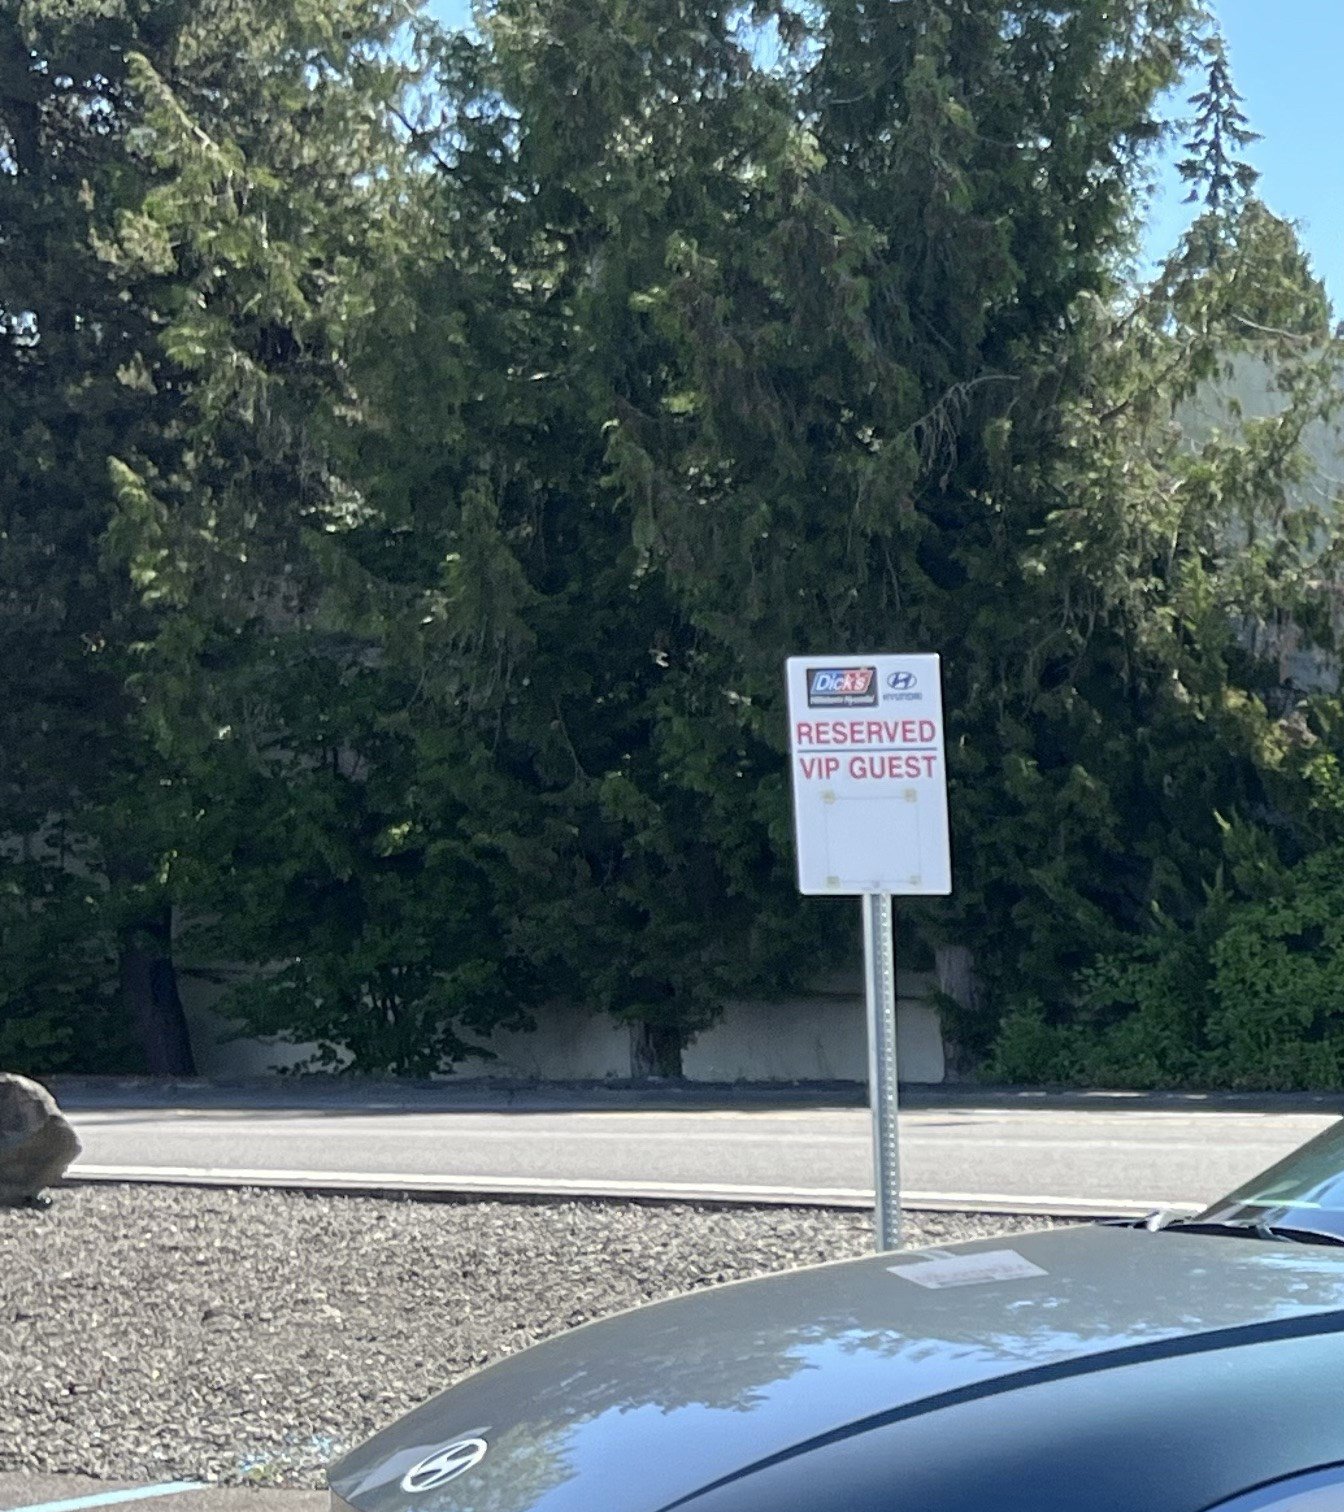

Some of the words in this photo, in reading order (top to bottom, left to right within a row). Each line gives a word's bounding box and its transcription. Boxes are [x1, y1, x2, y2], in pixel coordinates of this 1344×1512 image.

[797, 720, 936, 745] RESERVED
[801, 757, 840, 780] VIP
[849, 756, 937, 780] GUEST
